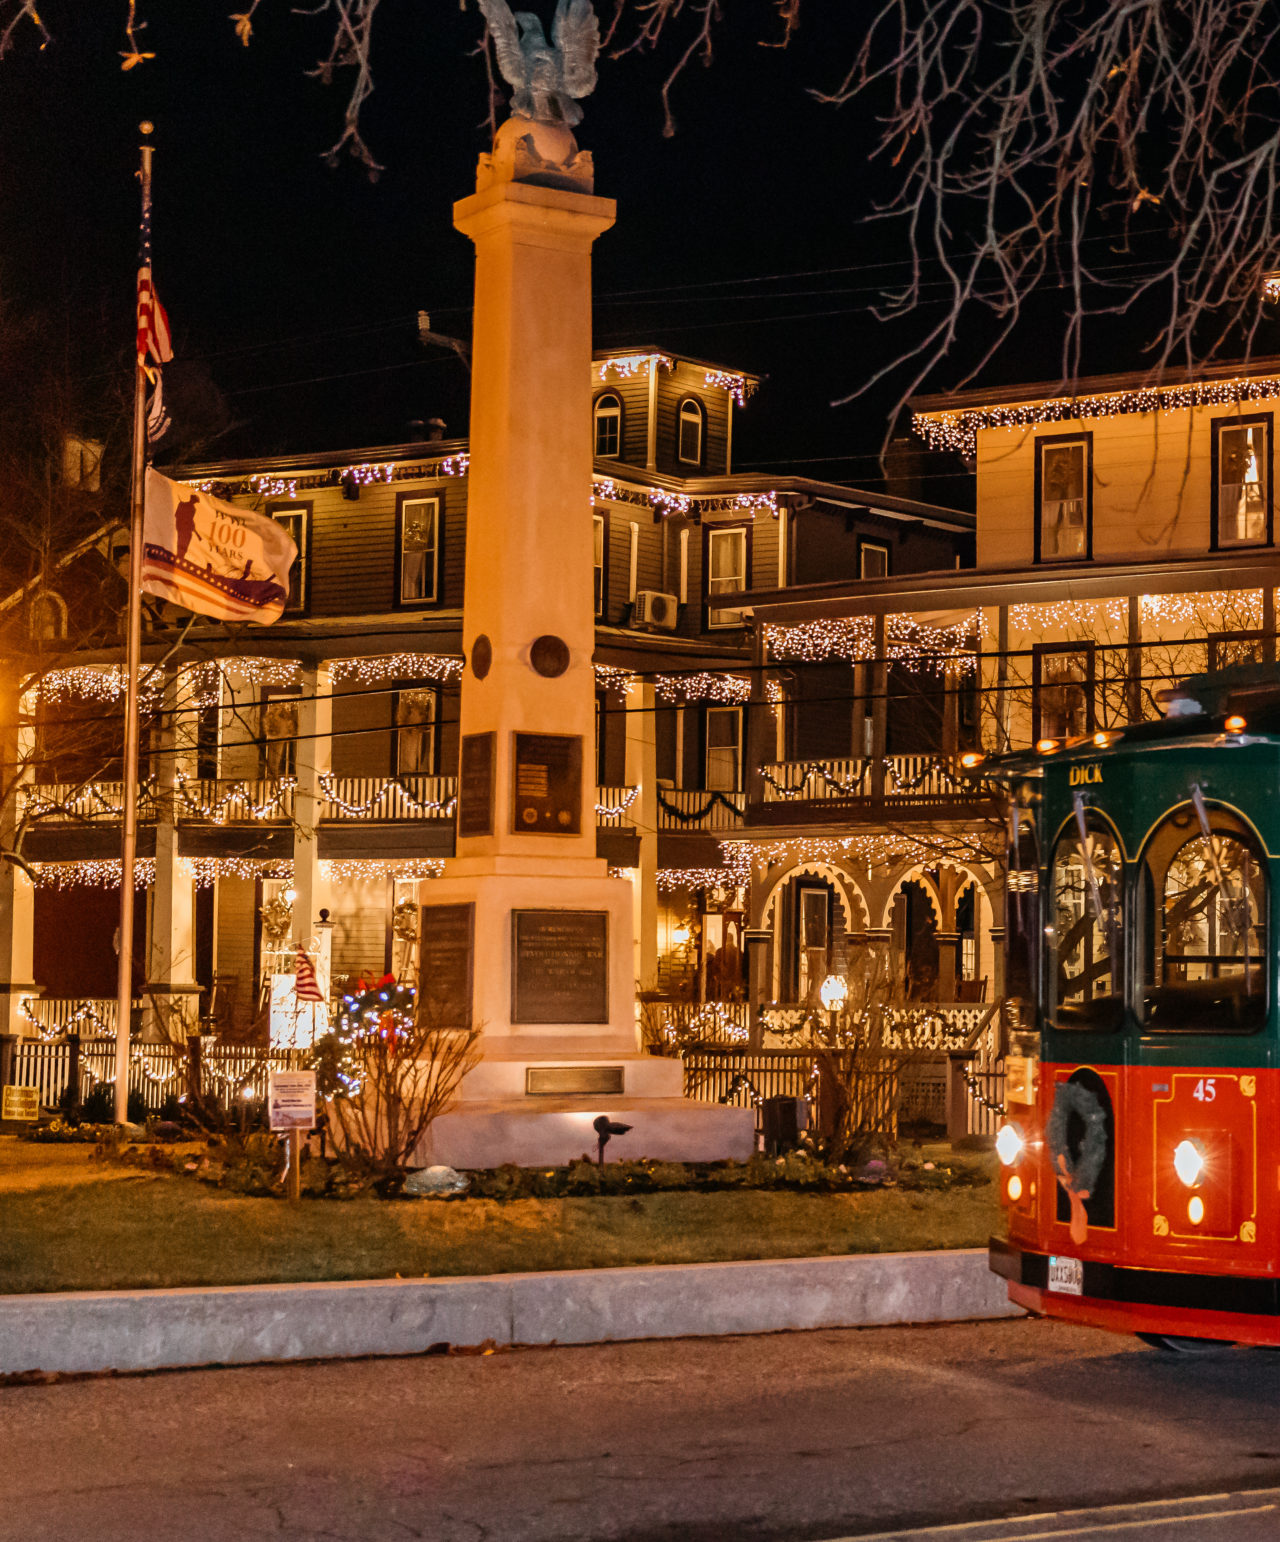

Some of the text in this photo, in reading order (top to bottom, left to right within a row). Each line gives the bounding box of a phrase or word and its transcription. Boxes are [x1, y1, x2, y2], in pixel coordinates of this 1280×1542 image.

[210, 521, 246, 548] 100
[1069, 763, 1104, 786] DICK
[1193, 1078, 1216, 1102] 45
